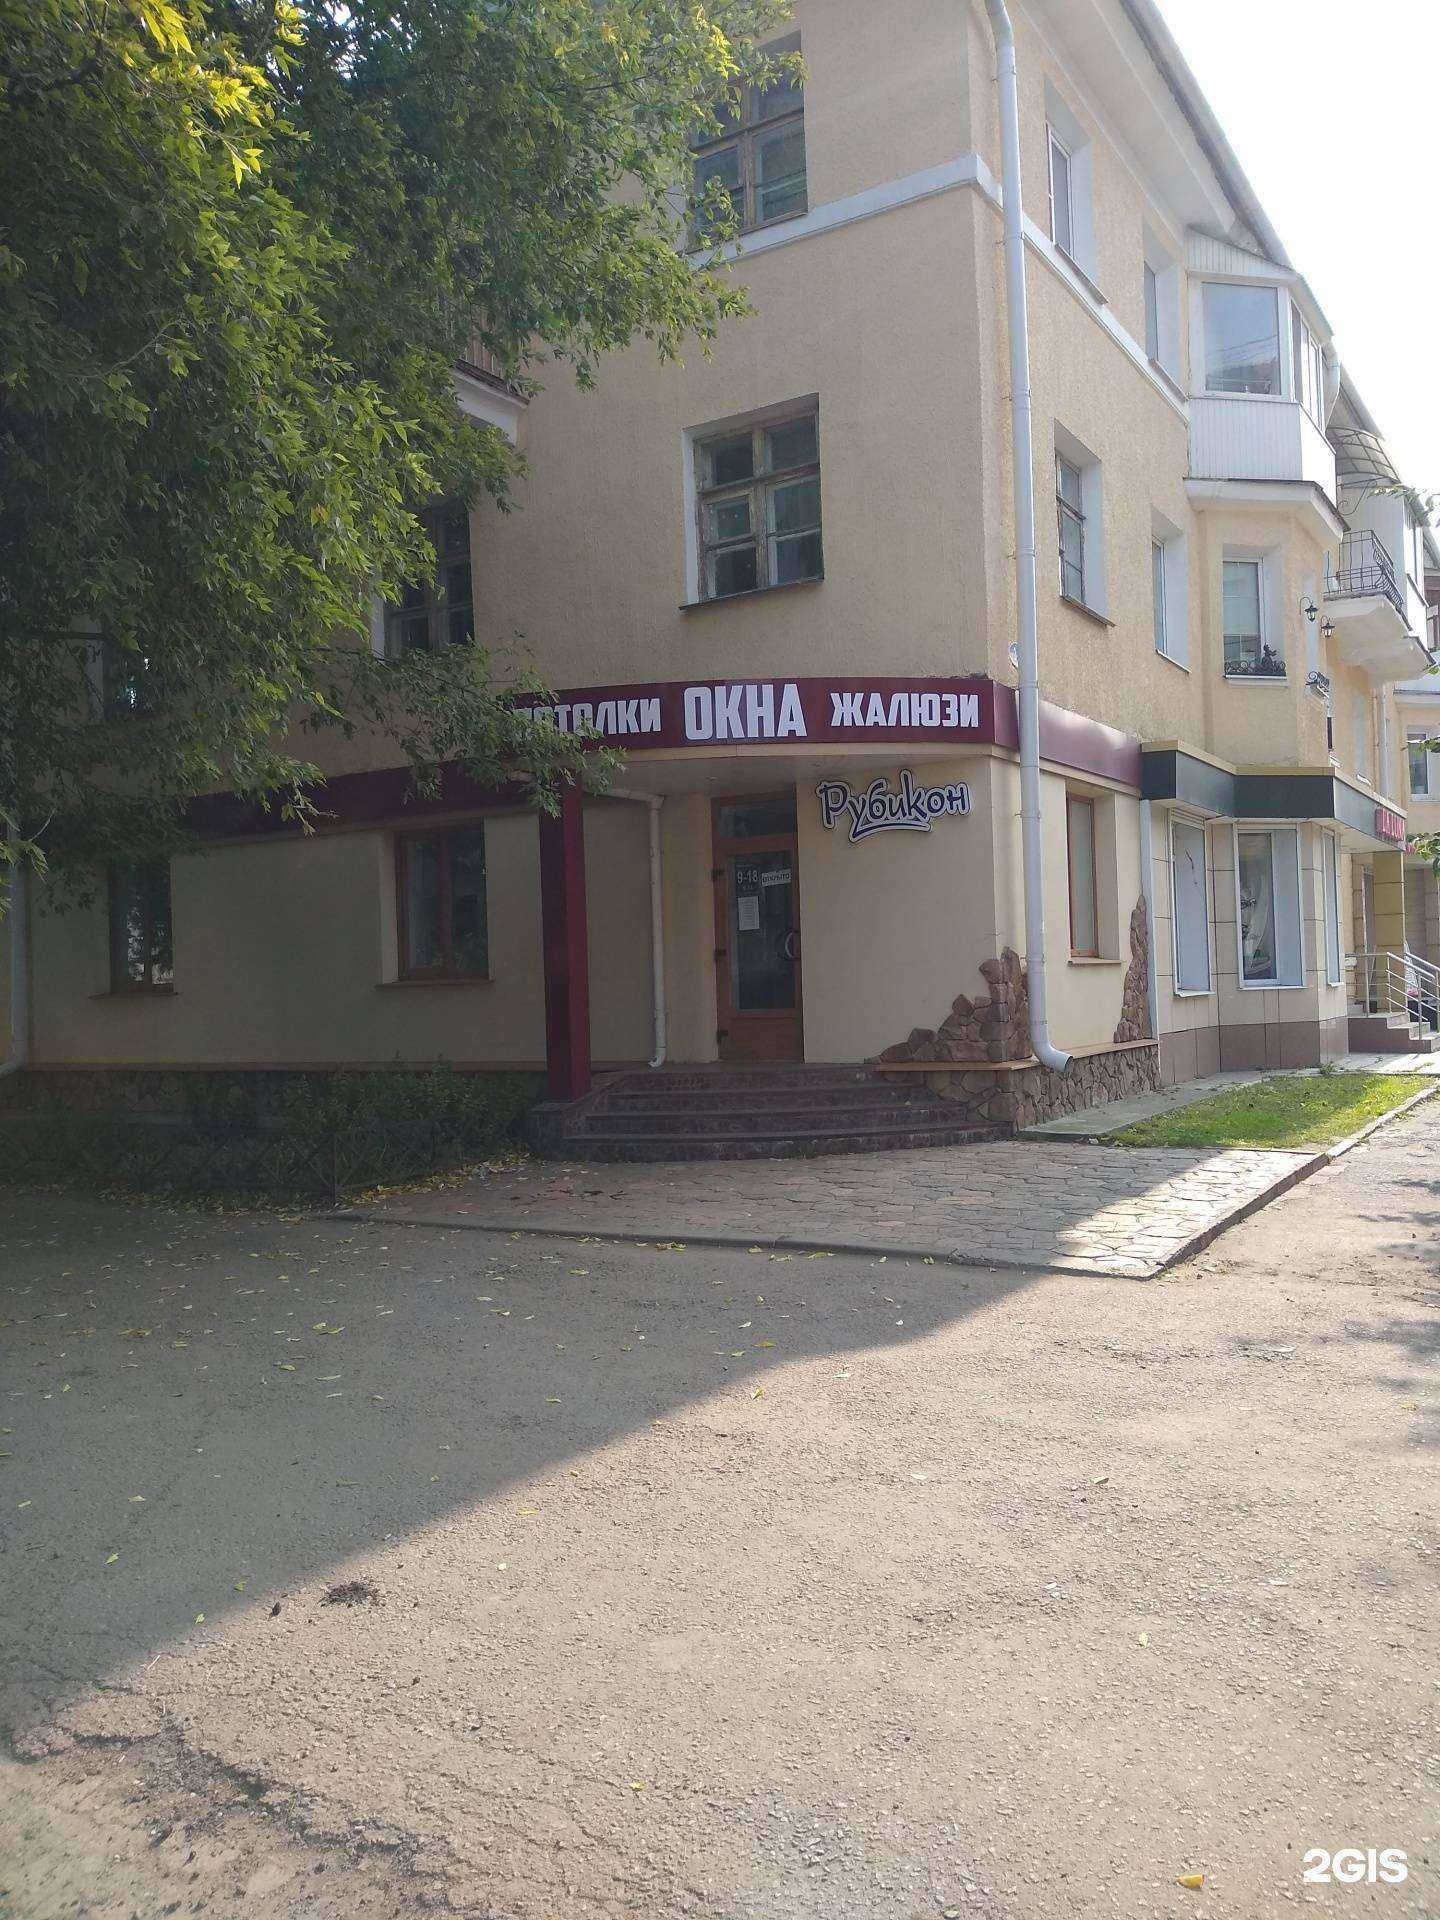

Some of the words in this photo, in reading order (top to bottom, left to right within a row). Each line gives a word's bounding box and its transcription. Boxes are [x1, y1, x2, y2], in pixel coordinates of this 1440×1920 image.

[684, 683, 807, 740] ОКНА
[830, 692, 978, 727] ЖАЛЮЗИ
[817, 770, 970, 841] Рубикон
